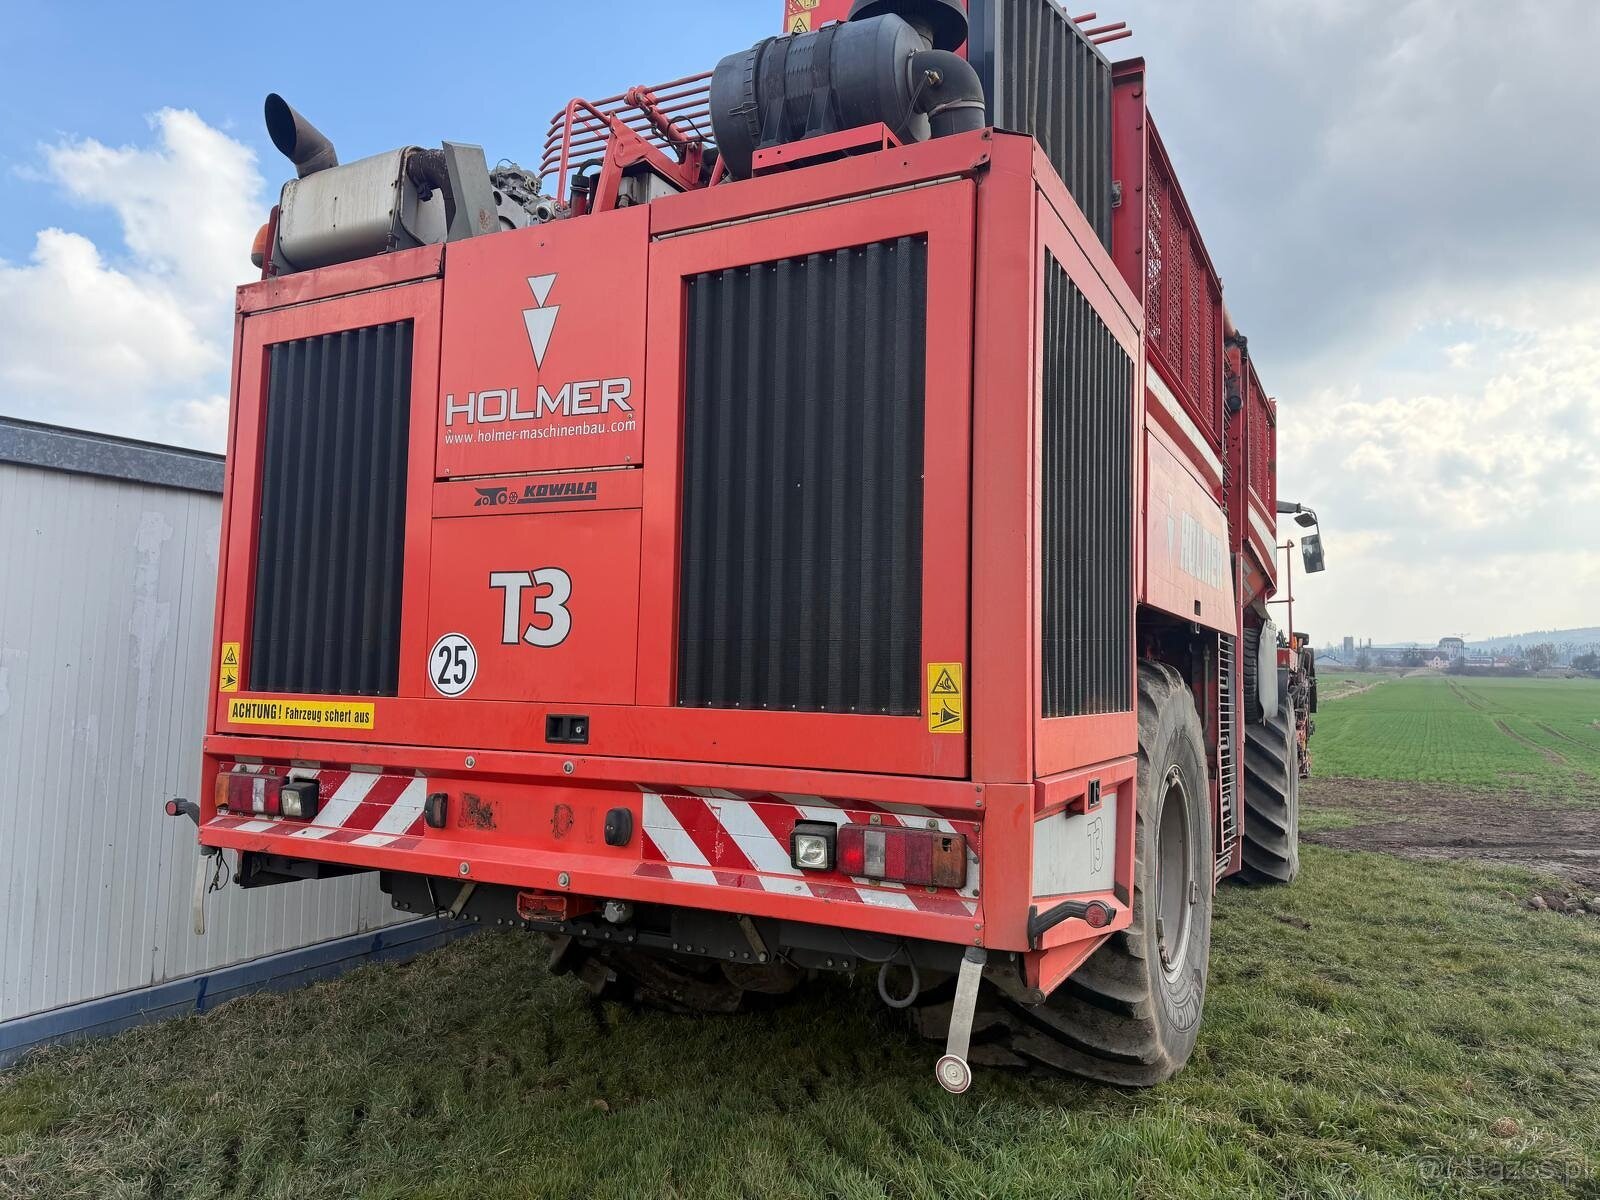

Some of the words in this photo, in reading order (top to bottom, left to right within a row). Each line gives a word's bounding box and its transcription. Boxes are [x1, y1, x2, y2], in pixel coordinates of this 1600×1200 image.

[445, 377, 635, 426] HOLMER
[445, 418, 636, 444] www.holmer-maschinenbau.com
[523, 481, 597, 498] KOWALA
[489, 566, 572, 648] T3
[437, 645, 468, 685] 25
[285, 707, 322, 722] Fahrzeug
[324, 708, 351, 723] schert
[354, 711, 370, 724] aus
[1087, 816, 1104, 876] T3
